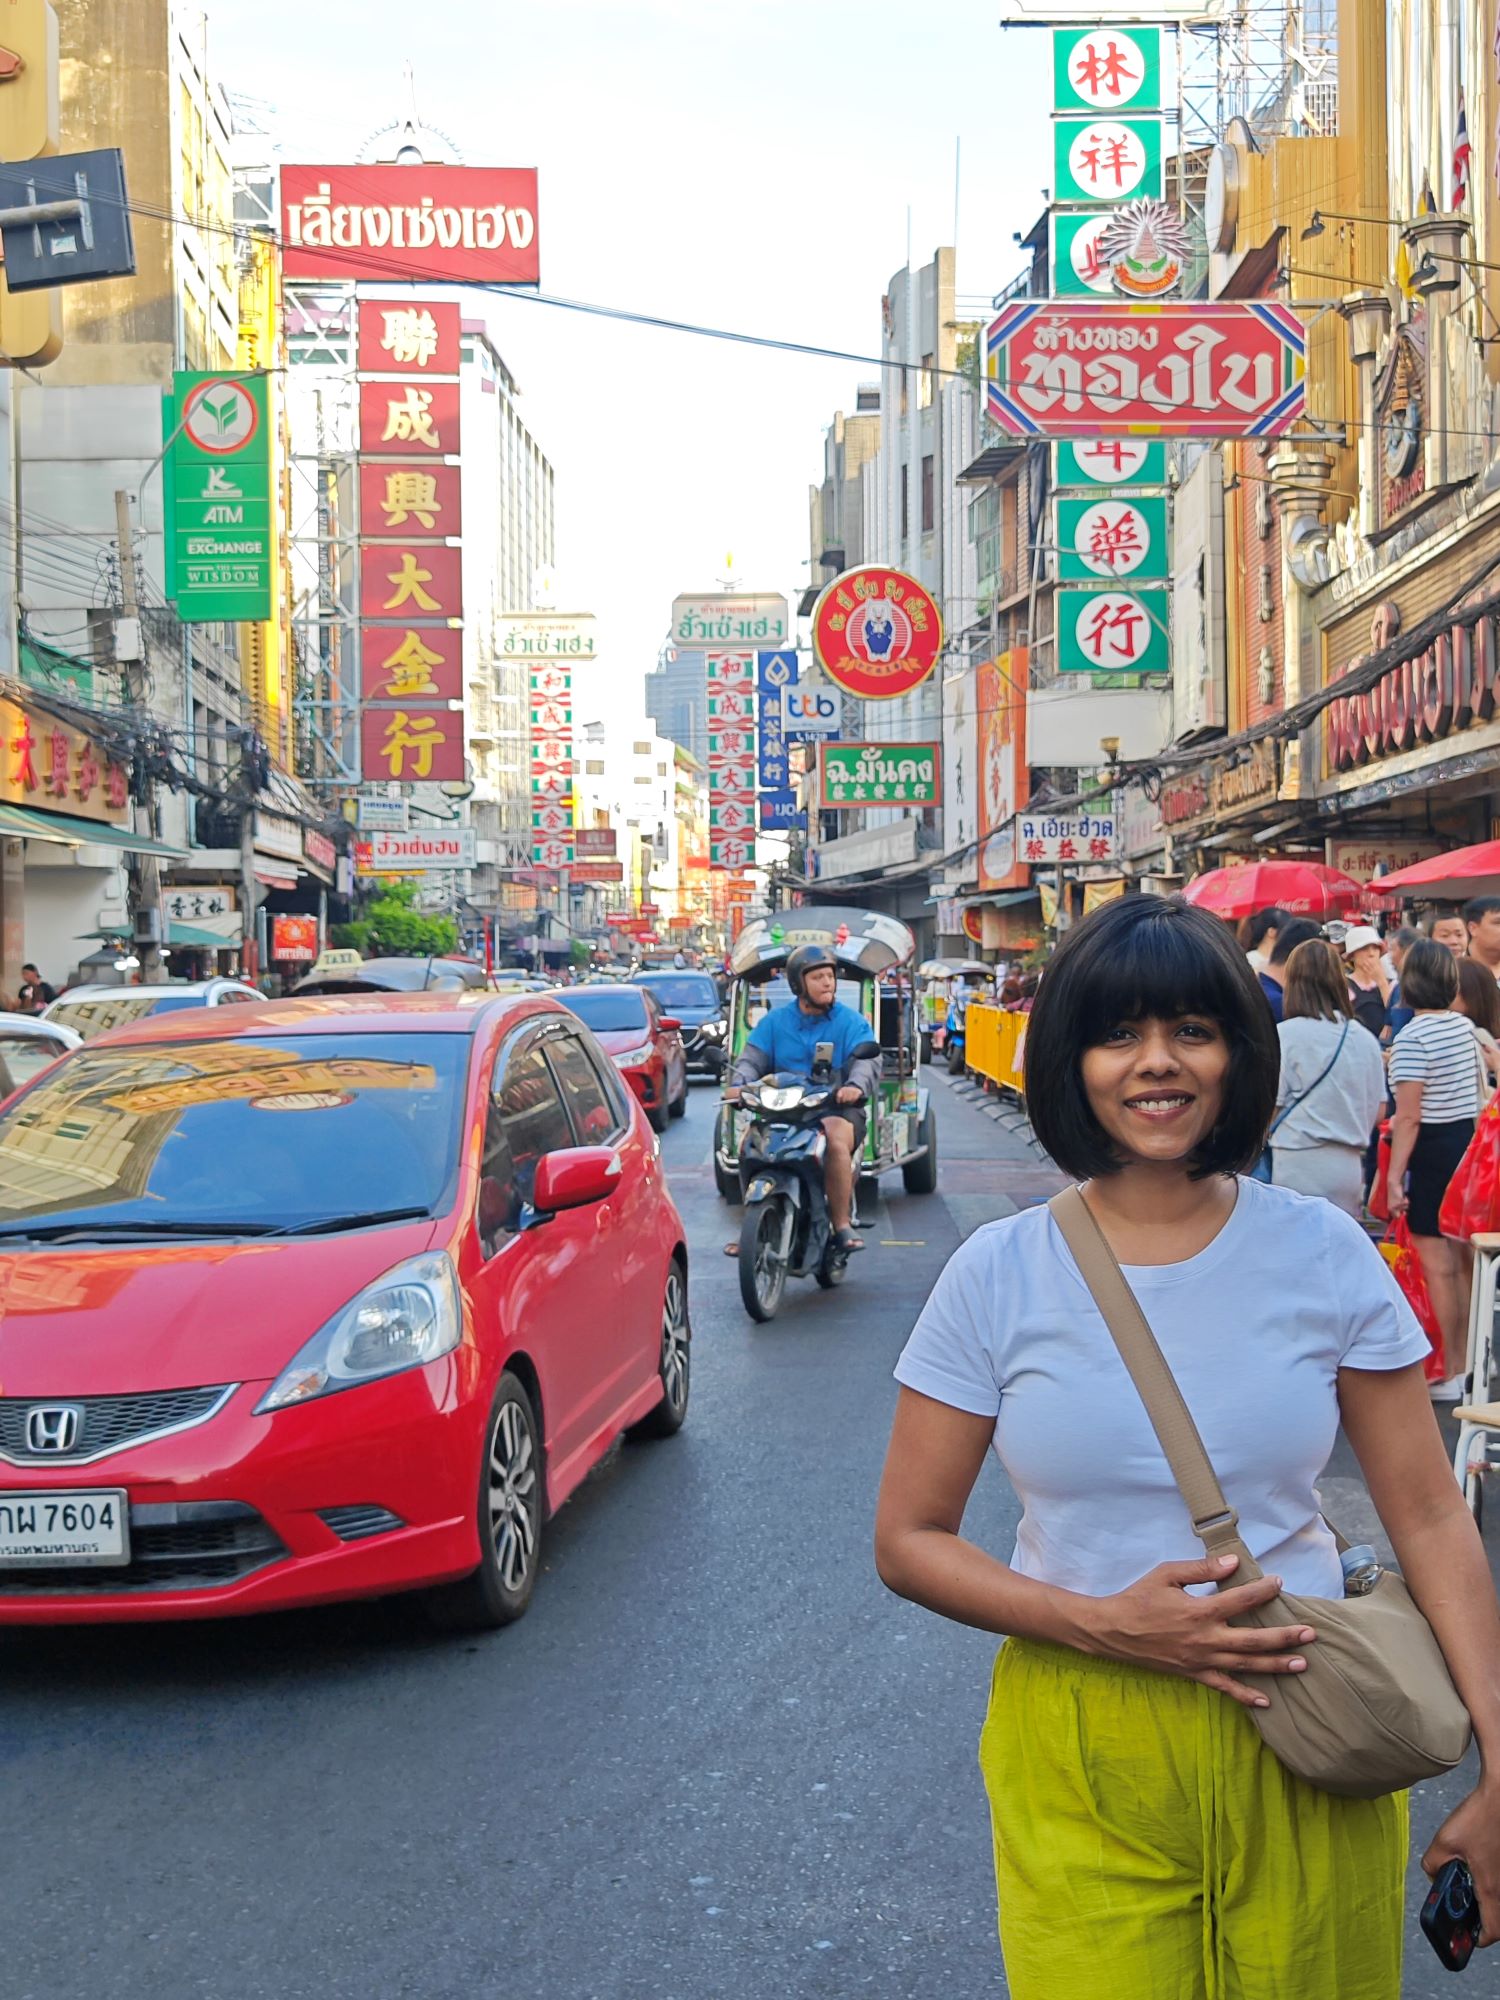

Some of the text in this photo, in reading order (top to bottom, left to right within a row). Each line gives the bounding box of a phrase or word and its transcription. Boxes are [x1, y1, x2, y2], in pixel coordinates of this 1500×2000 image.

[287, 182, 535, 249] เลี่ยงเซ่งเฮง
[1032, 315, 1159, 351] ห้างทอง
[1016, 322, 1275, 414] ทองใบ
[208, 466, 237, 490] K
[203, 505, 243, 524] ATM
[187, 541, 262, 555] EXCHANGE
[379, 307, 447, 779] 聯成興大金行
[187, 572, 259, 582] WISDOM
[788, 693, 835, 718] ttb
[719, 657, 744, 865] 和成興大金行
[826, 746, 933, 784] ฉ.มั่นคง
[794, 932, 825, 942] TAXI
[325, 953, 351, 965] TAXI
[44, 1502, 115, 1533] 7604
